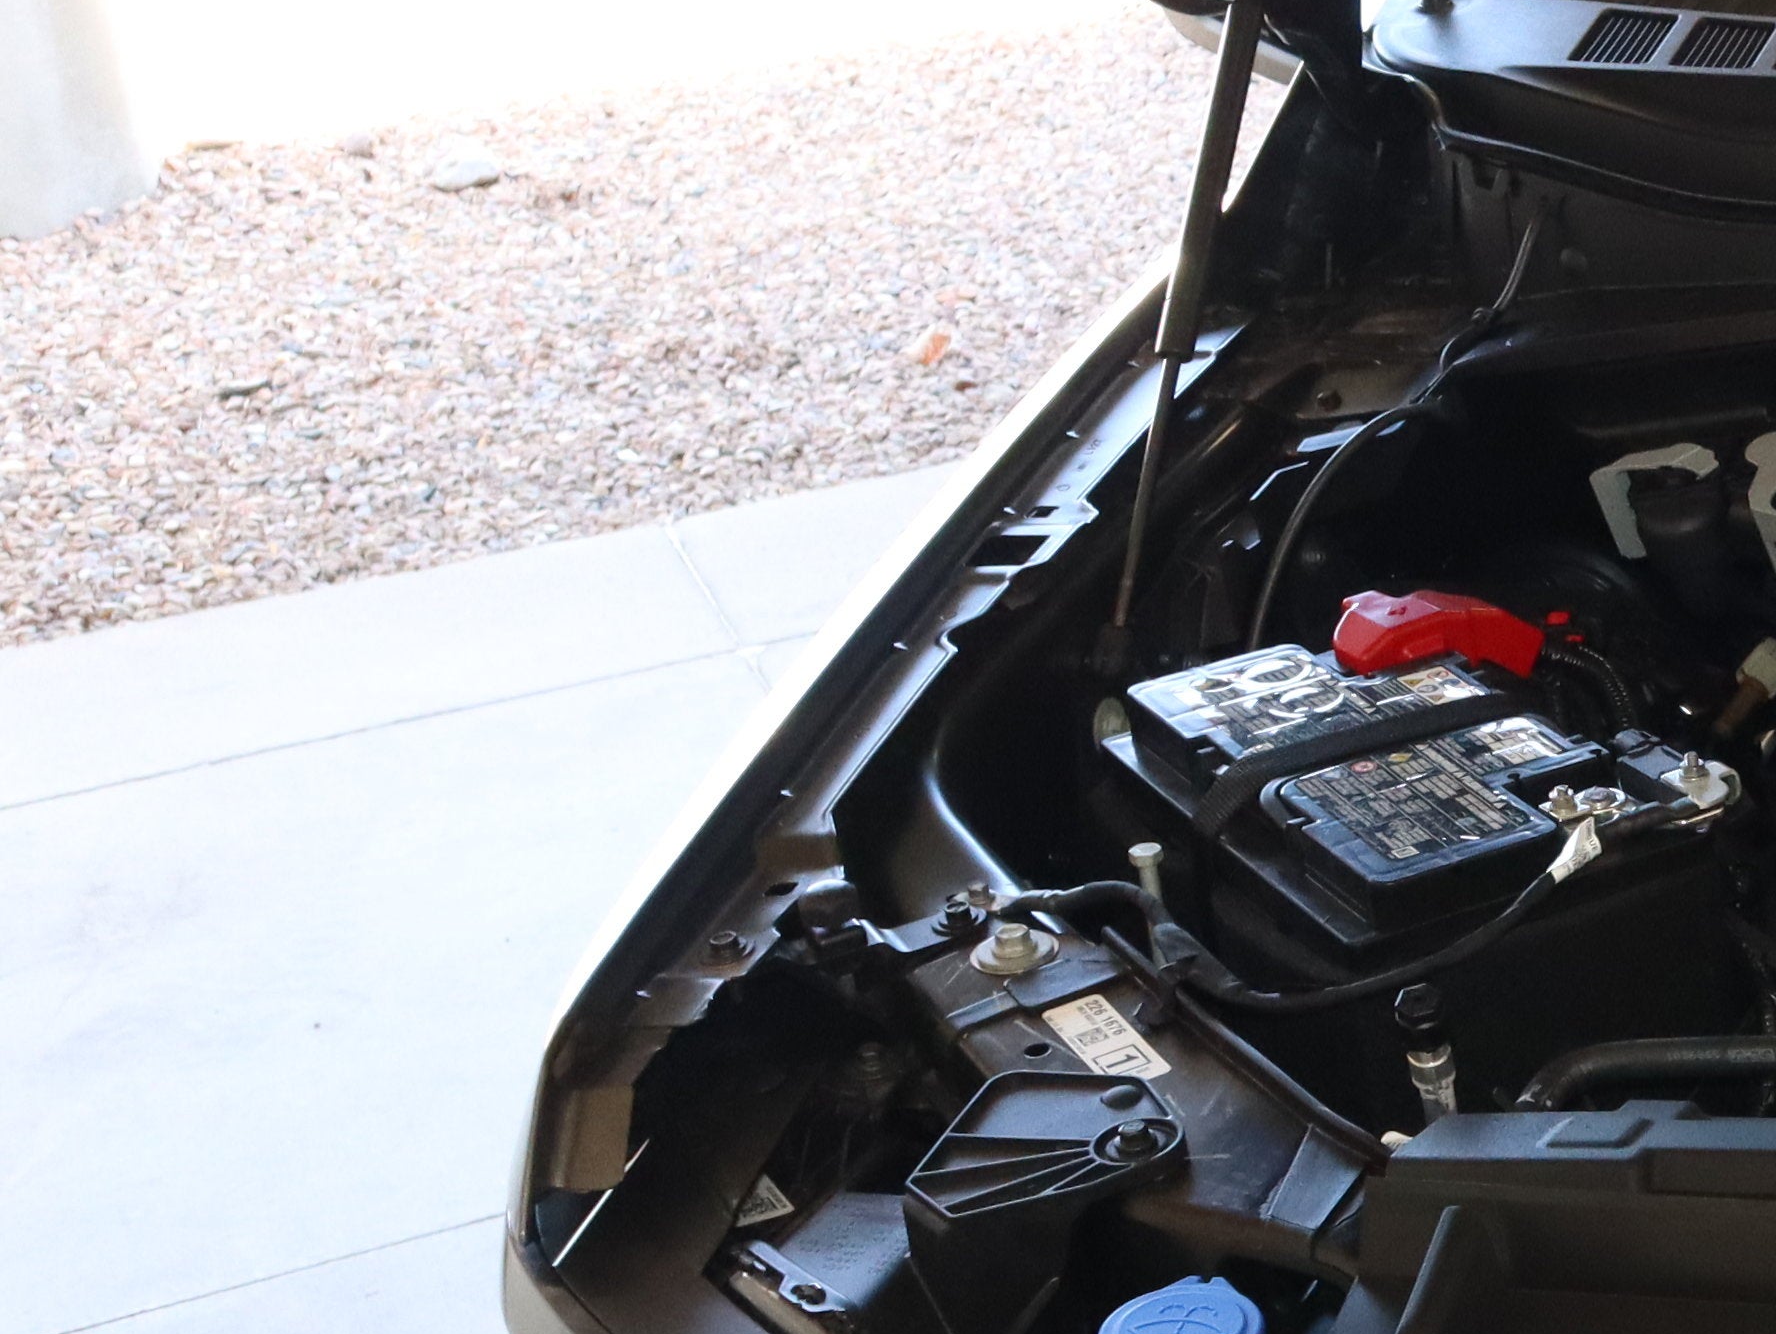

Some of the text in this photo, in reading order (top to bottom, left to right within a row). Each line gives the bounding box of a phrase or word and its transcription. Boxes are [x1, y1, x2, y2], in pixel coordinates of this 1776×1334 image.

[1084, 999, 1108, 1016] 226
[1101, 1016, 1127, 1036] 1676
[1105, 1053, 1140, 1069] 1
